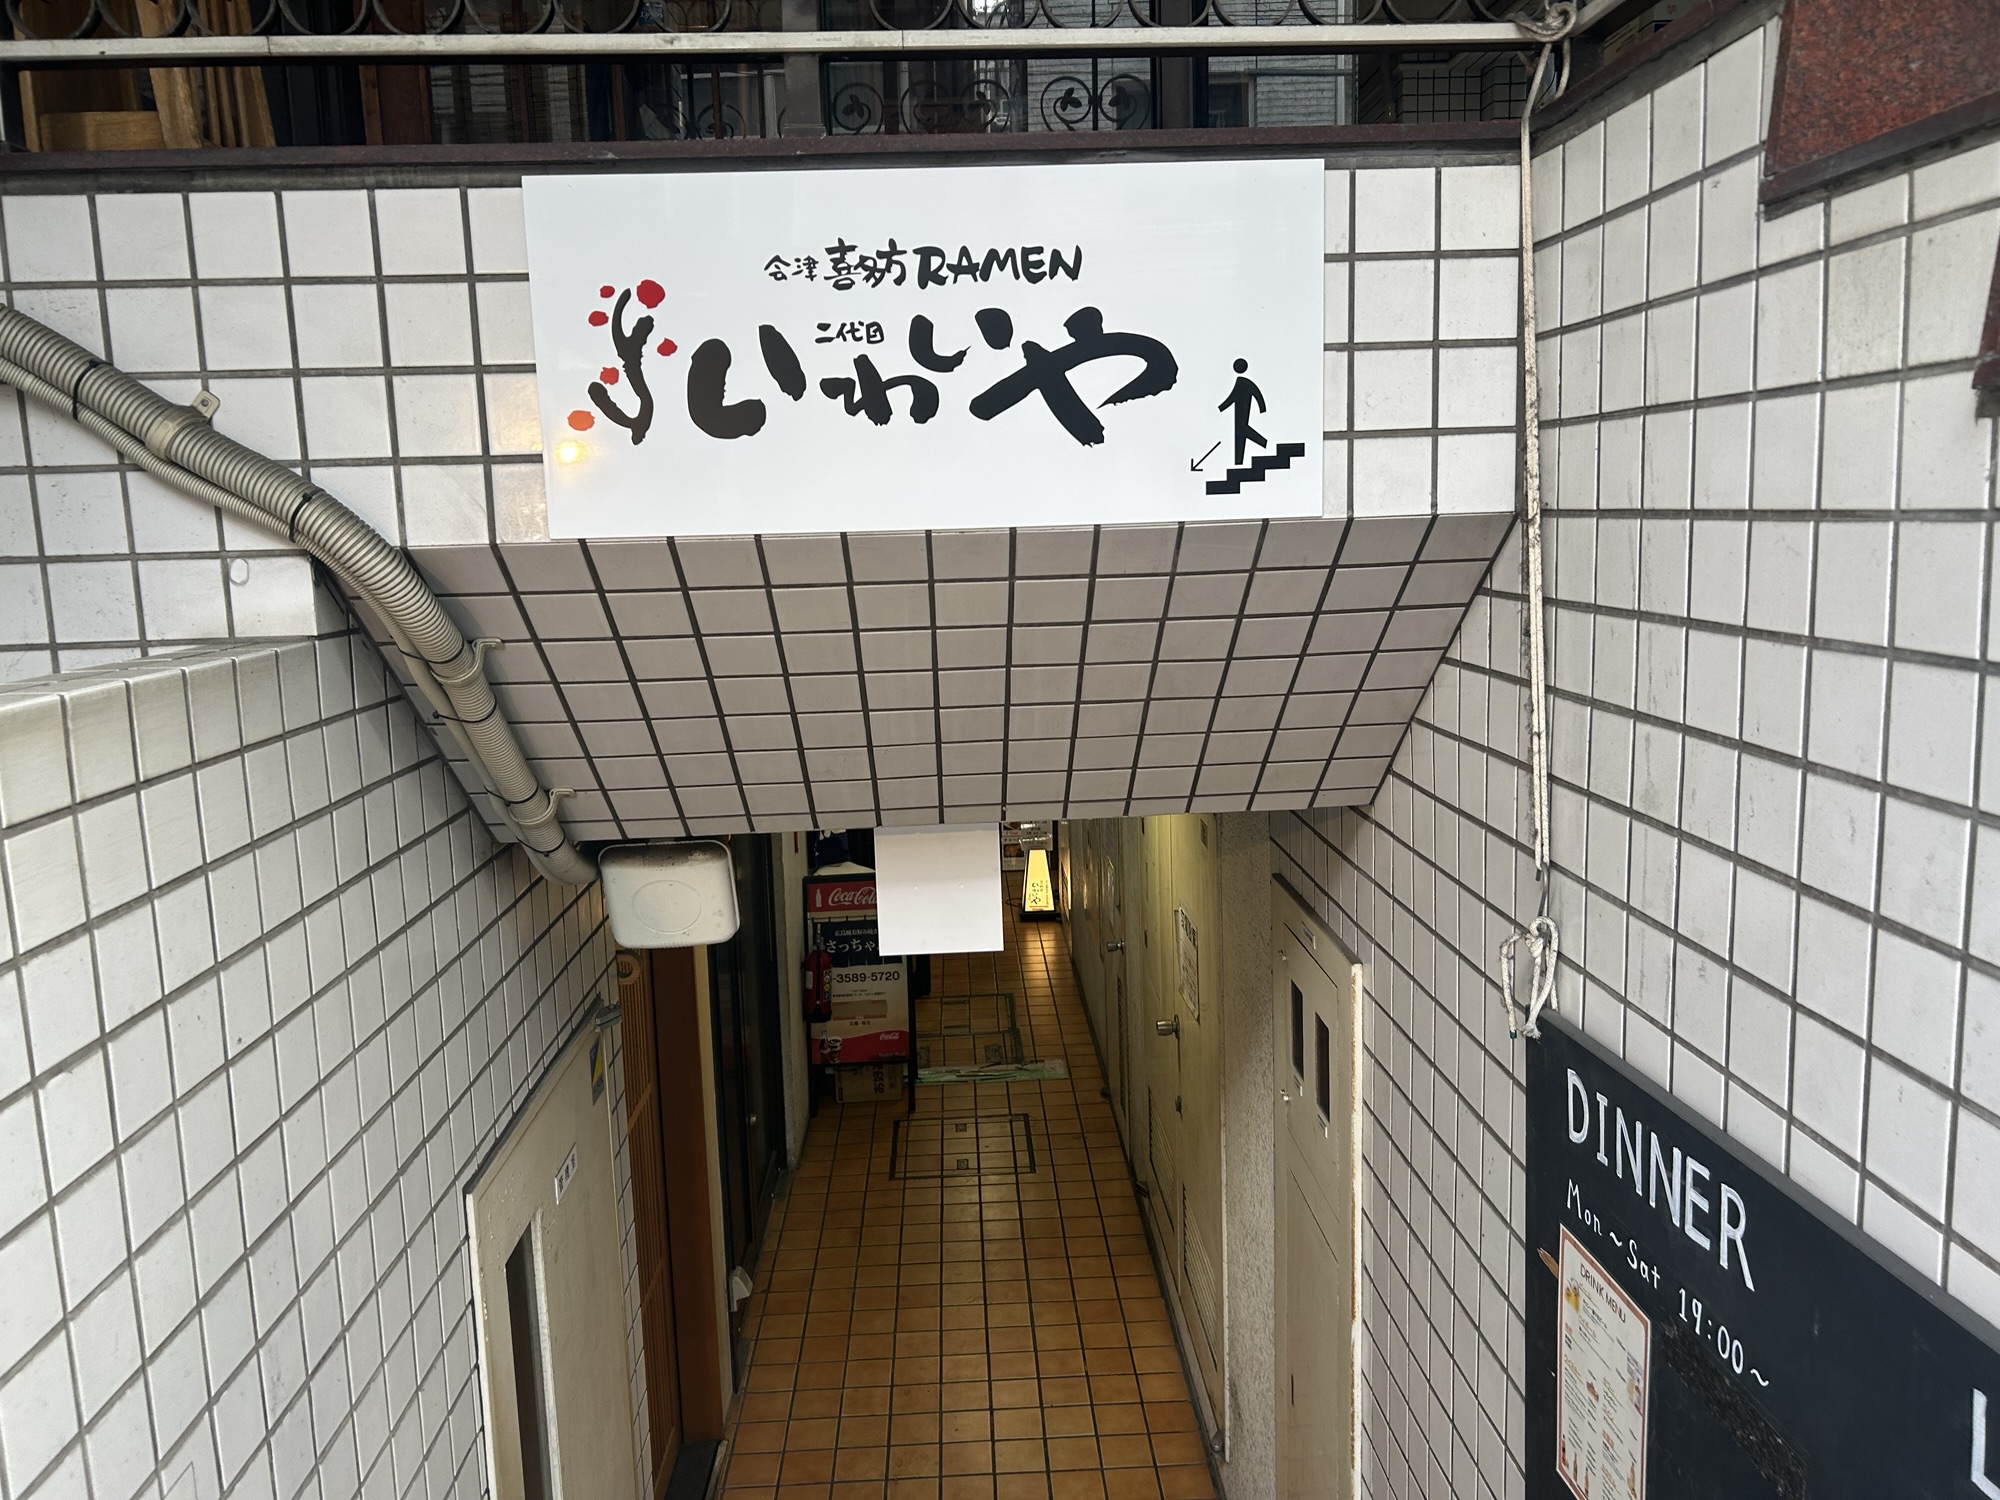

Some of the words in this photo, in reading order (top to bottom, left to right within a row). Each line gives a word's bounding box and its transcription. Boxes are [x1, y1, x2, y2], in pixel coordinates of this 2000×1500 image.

[912, 245, 1083, 290] RAMEN
[815, 320, 885, 344] 二代目
[686, 306, 1179, 447] いわいや
[825, 938, 879, 953] さっちゃ
[1567, 1068, 1756, 1292] DINNER
[1580, 1262, 1605, 1301] DRINK
[1605, 1291, 1627, 1324] MENU
